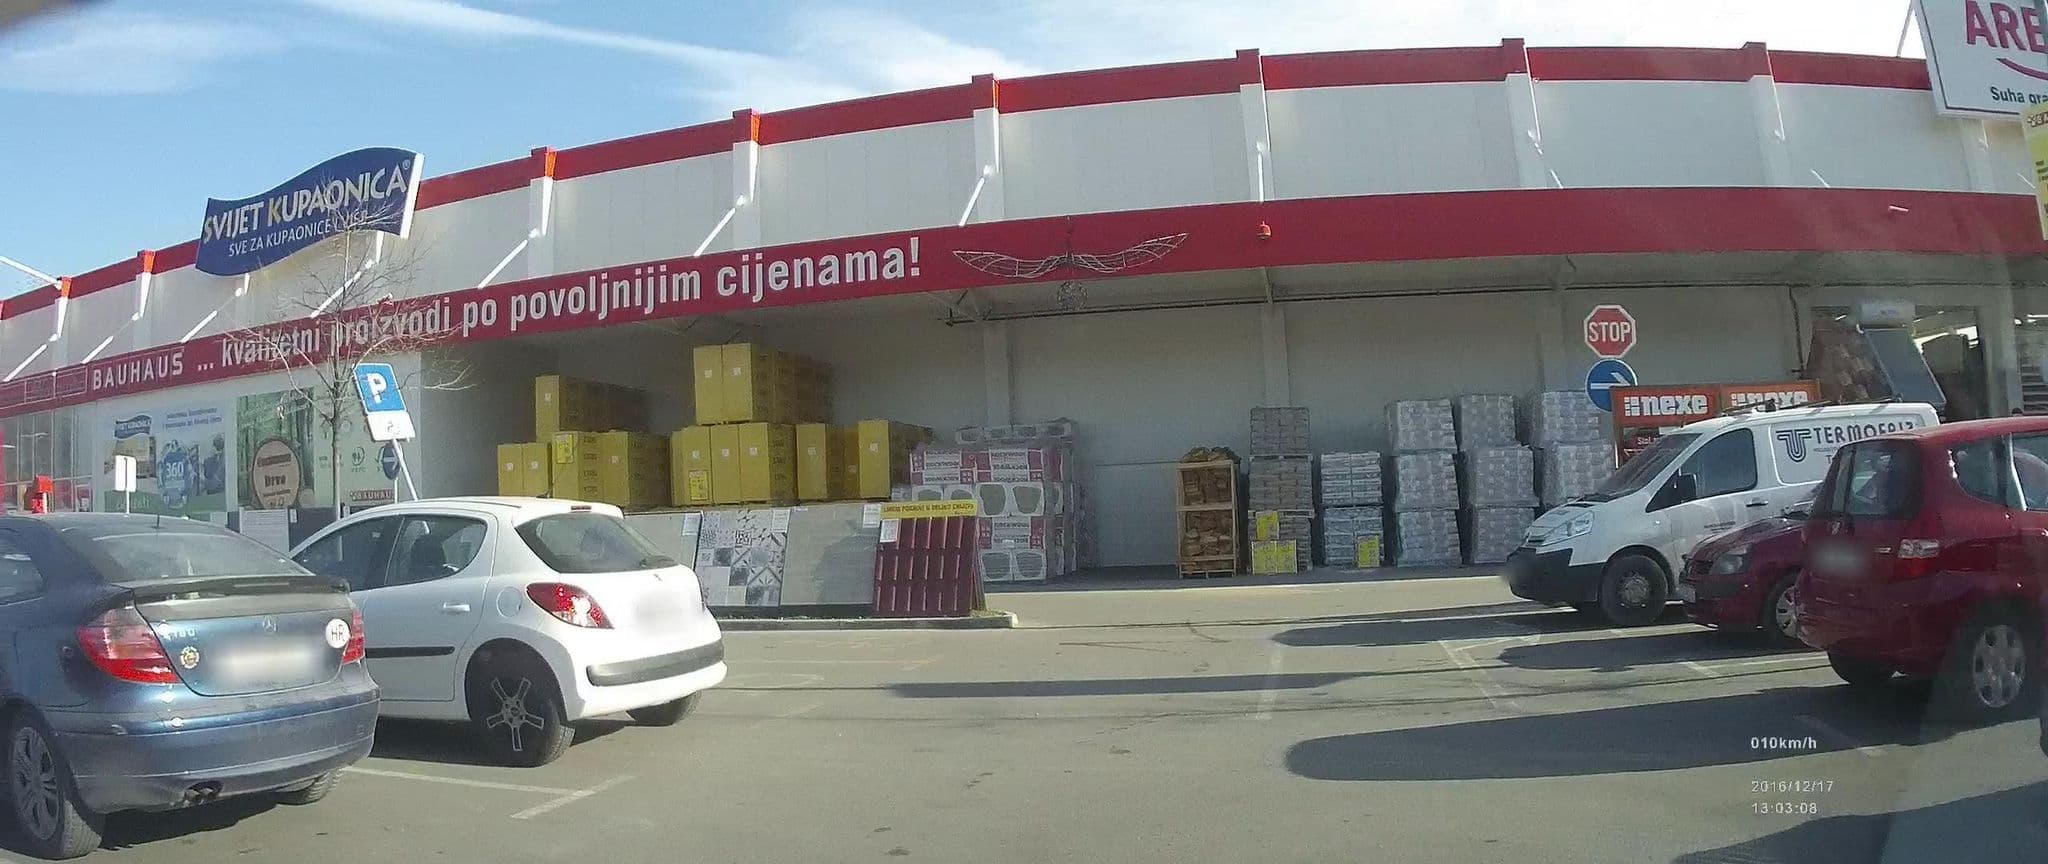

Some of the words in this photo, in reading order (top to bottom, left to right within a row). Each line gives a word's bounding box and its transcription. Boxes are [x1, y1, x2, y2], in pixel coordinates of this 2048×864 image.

[1990, 86, 2025, 103] Suha
[204, 200, 264, 244] SVIJET
[229, 241, 248, 257] SVE
[250, 237, 264, 251] ZA
[267, 218, 331, 246] KUPAONICE
[93, 352, 184, 390] BAUHAUS
[222, 327, 320, 367] kvalitetni
[331, 297, 450, 359] proizvodi
[463, 297, 498, 337] po
[511, 265, 701, 331] povoljnijim
[717, 237, 920, 302] cijenama!
[1588, 321, 1632, 343] STOP
[367, 373, 387, 403] P
[1641, 394, 1709, 416] nexe
[166, 461, 184, 478] 360
[331, 624, 345, 642] HR
